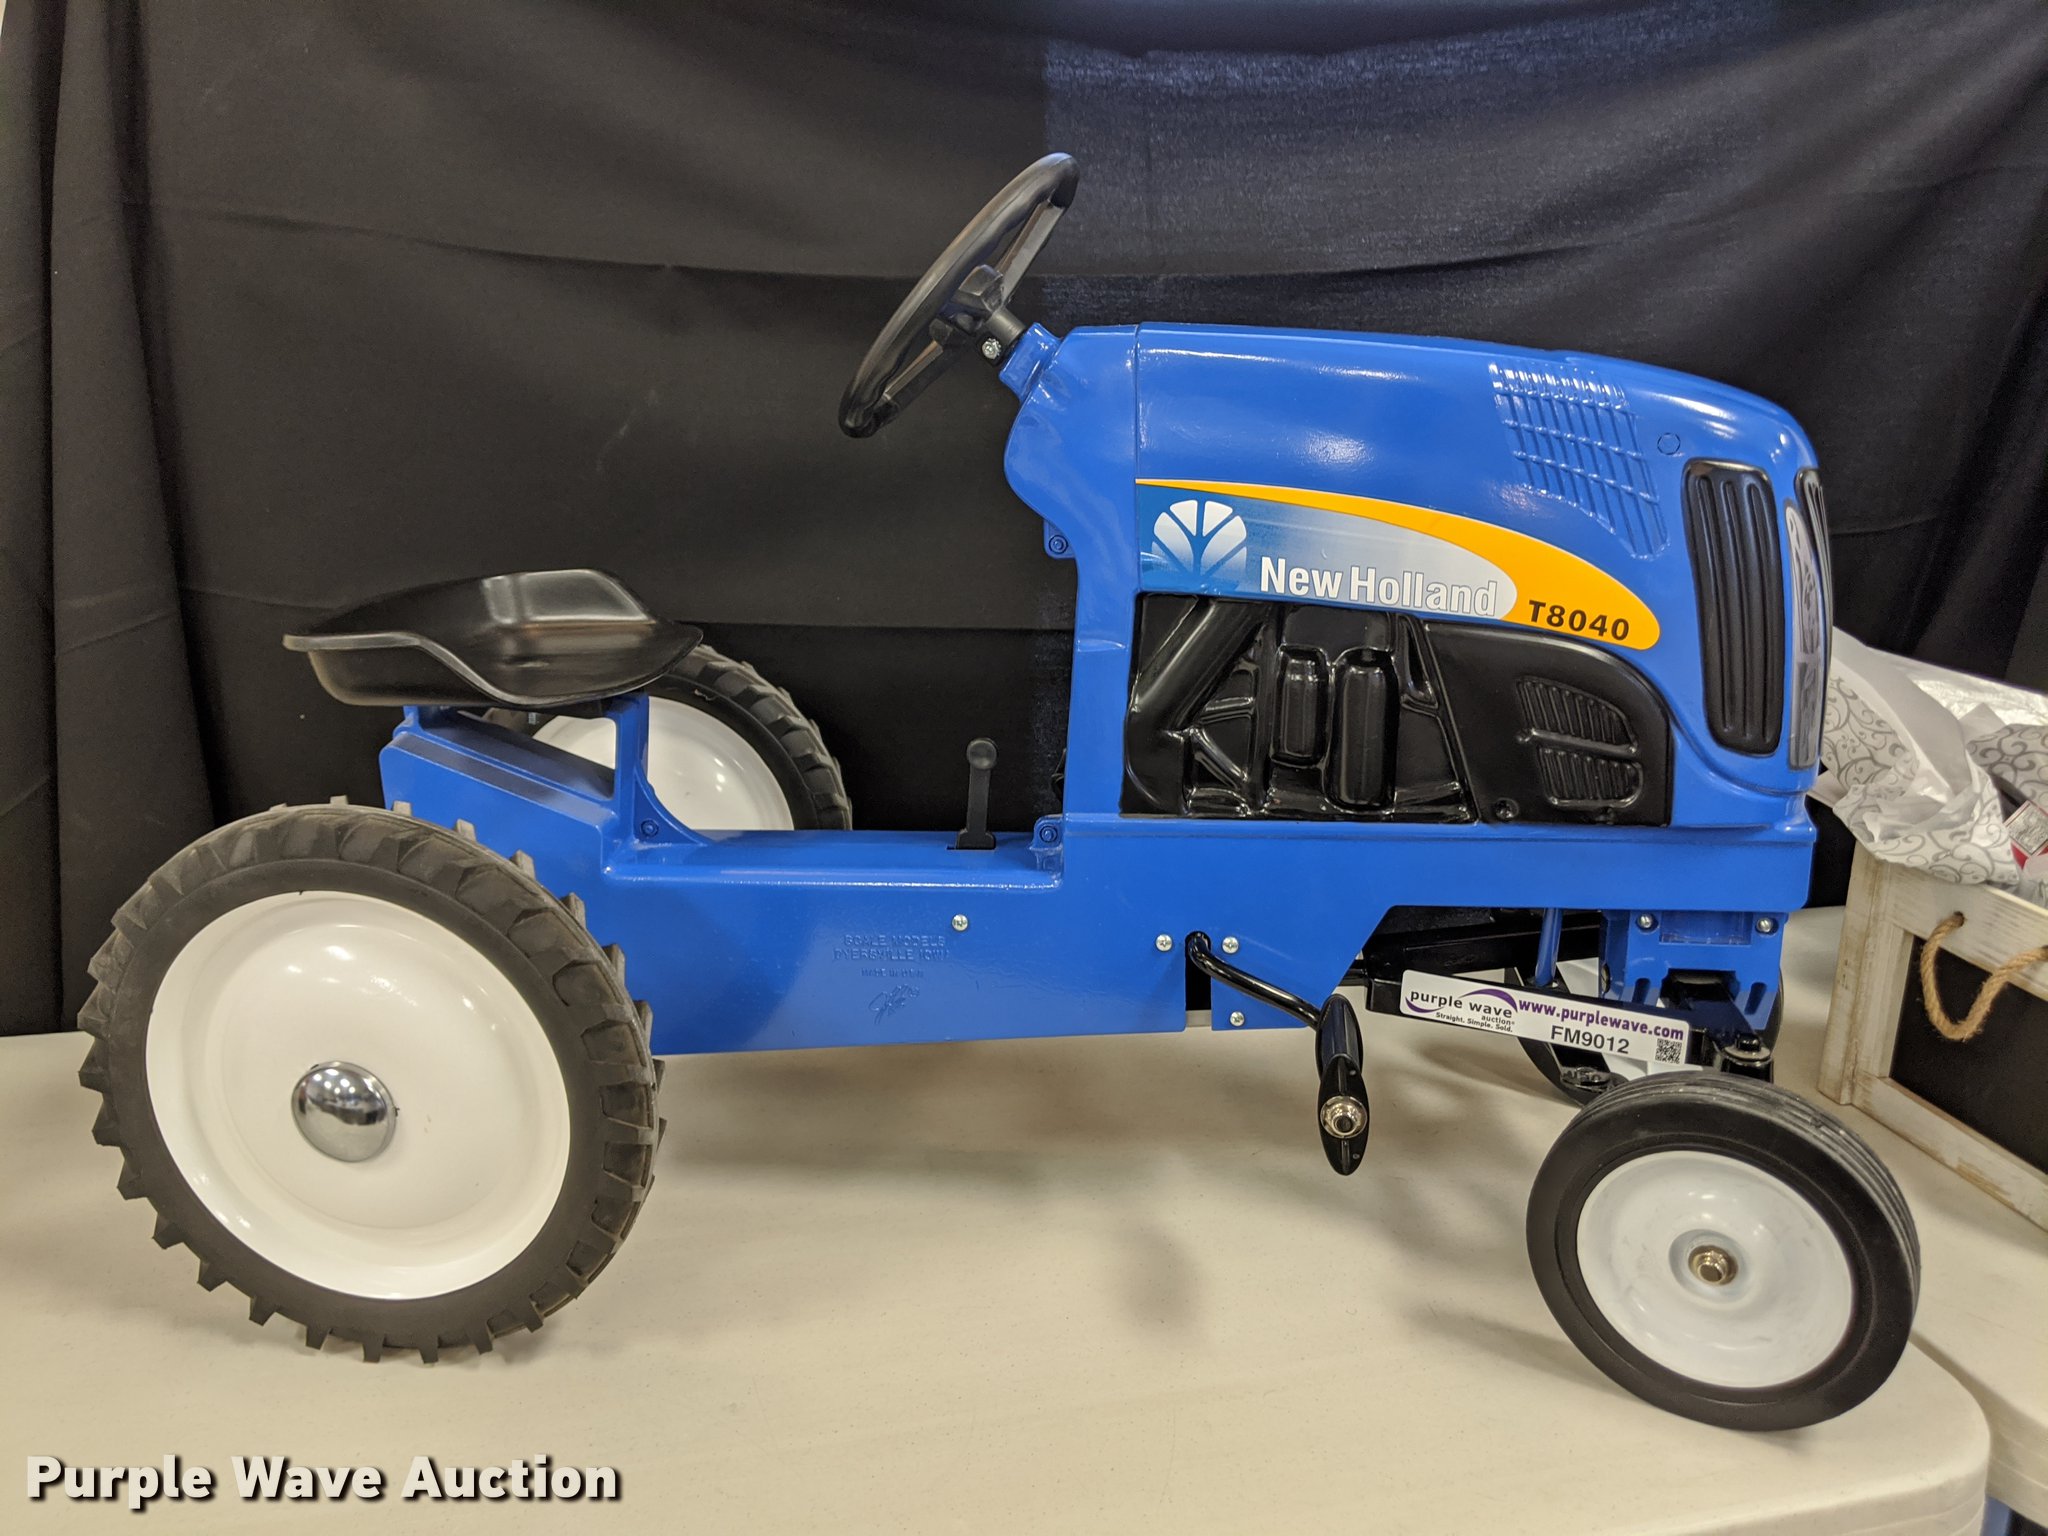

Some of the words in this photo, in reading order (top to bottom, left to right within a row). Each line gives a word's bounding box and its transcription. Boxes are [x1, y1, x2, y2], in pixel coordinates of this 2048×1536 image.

[1260, 556, 1343, 600] New
[1350, 565, 1499, 618] Holland
[1528, 600, 1631, 642] T8040
[1410, 991, 1463, 1008] purple
[1469, 1001, 1512, 1018] wave
[1436, 1012, 1465, 1023] Straight.
[1519, 999, 1684, 1041] www.purplewave.com
[1551, 1025, 1630, 1054] FM9012
